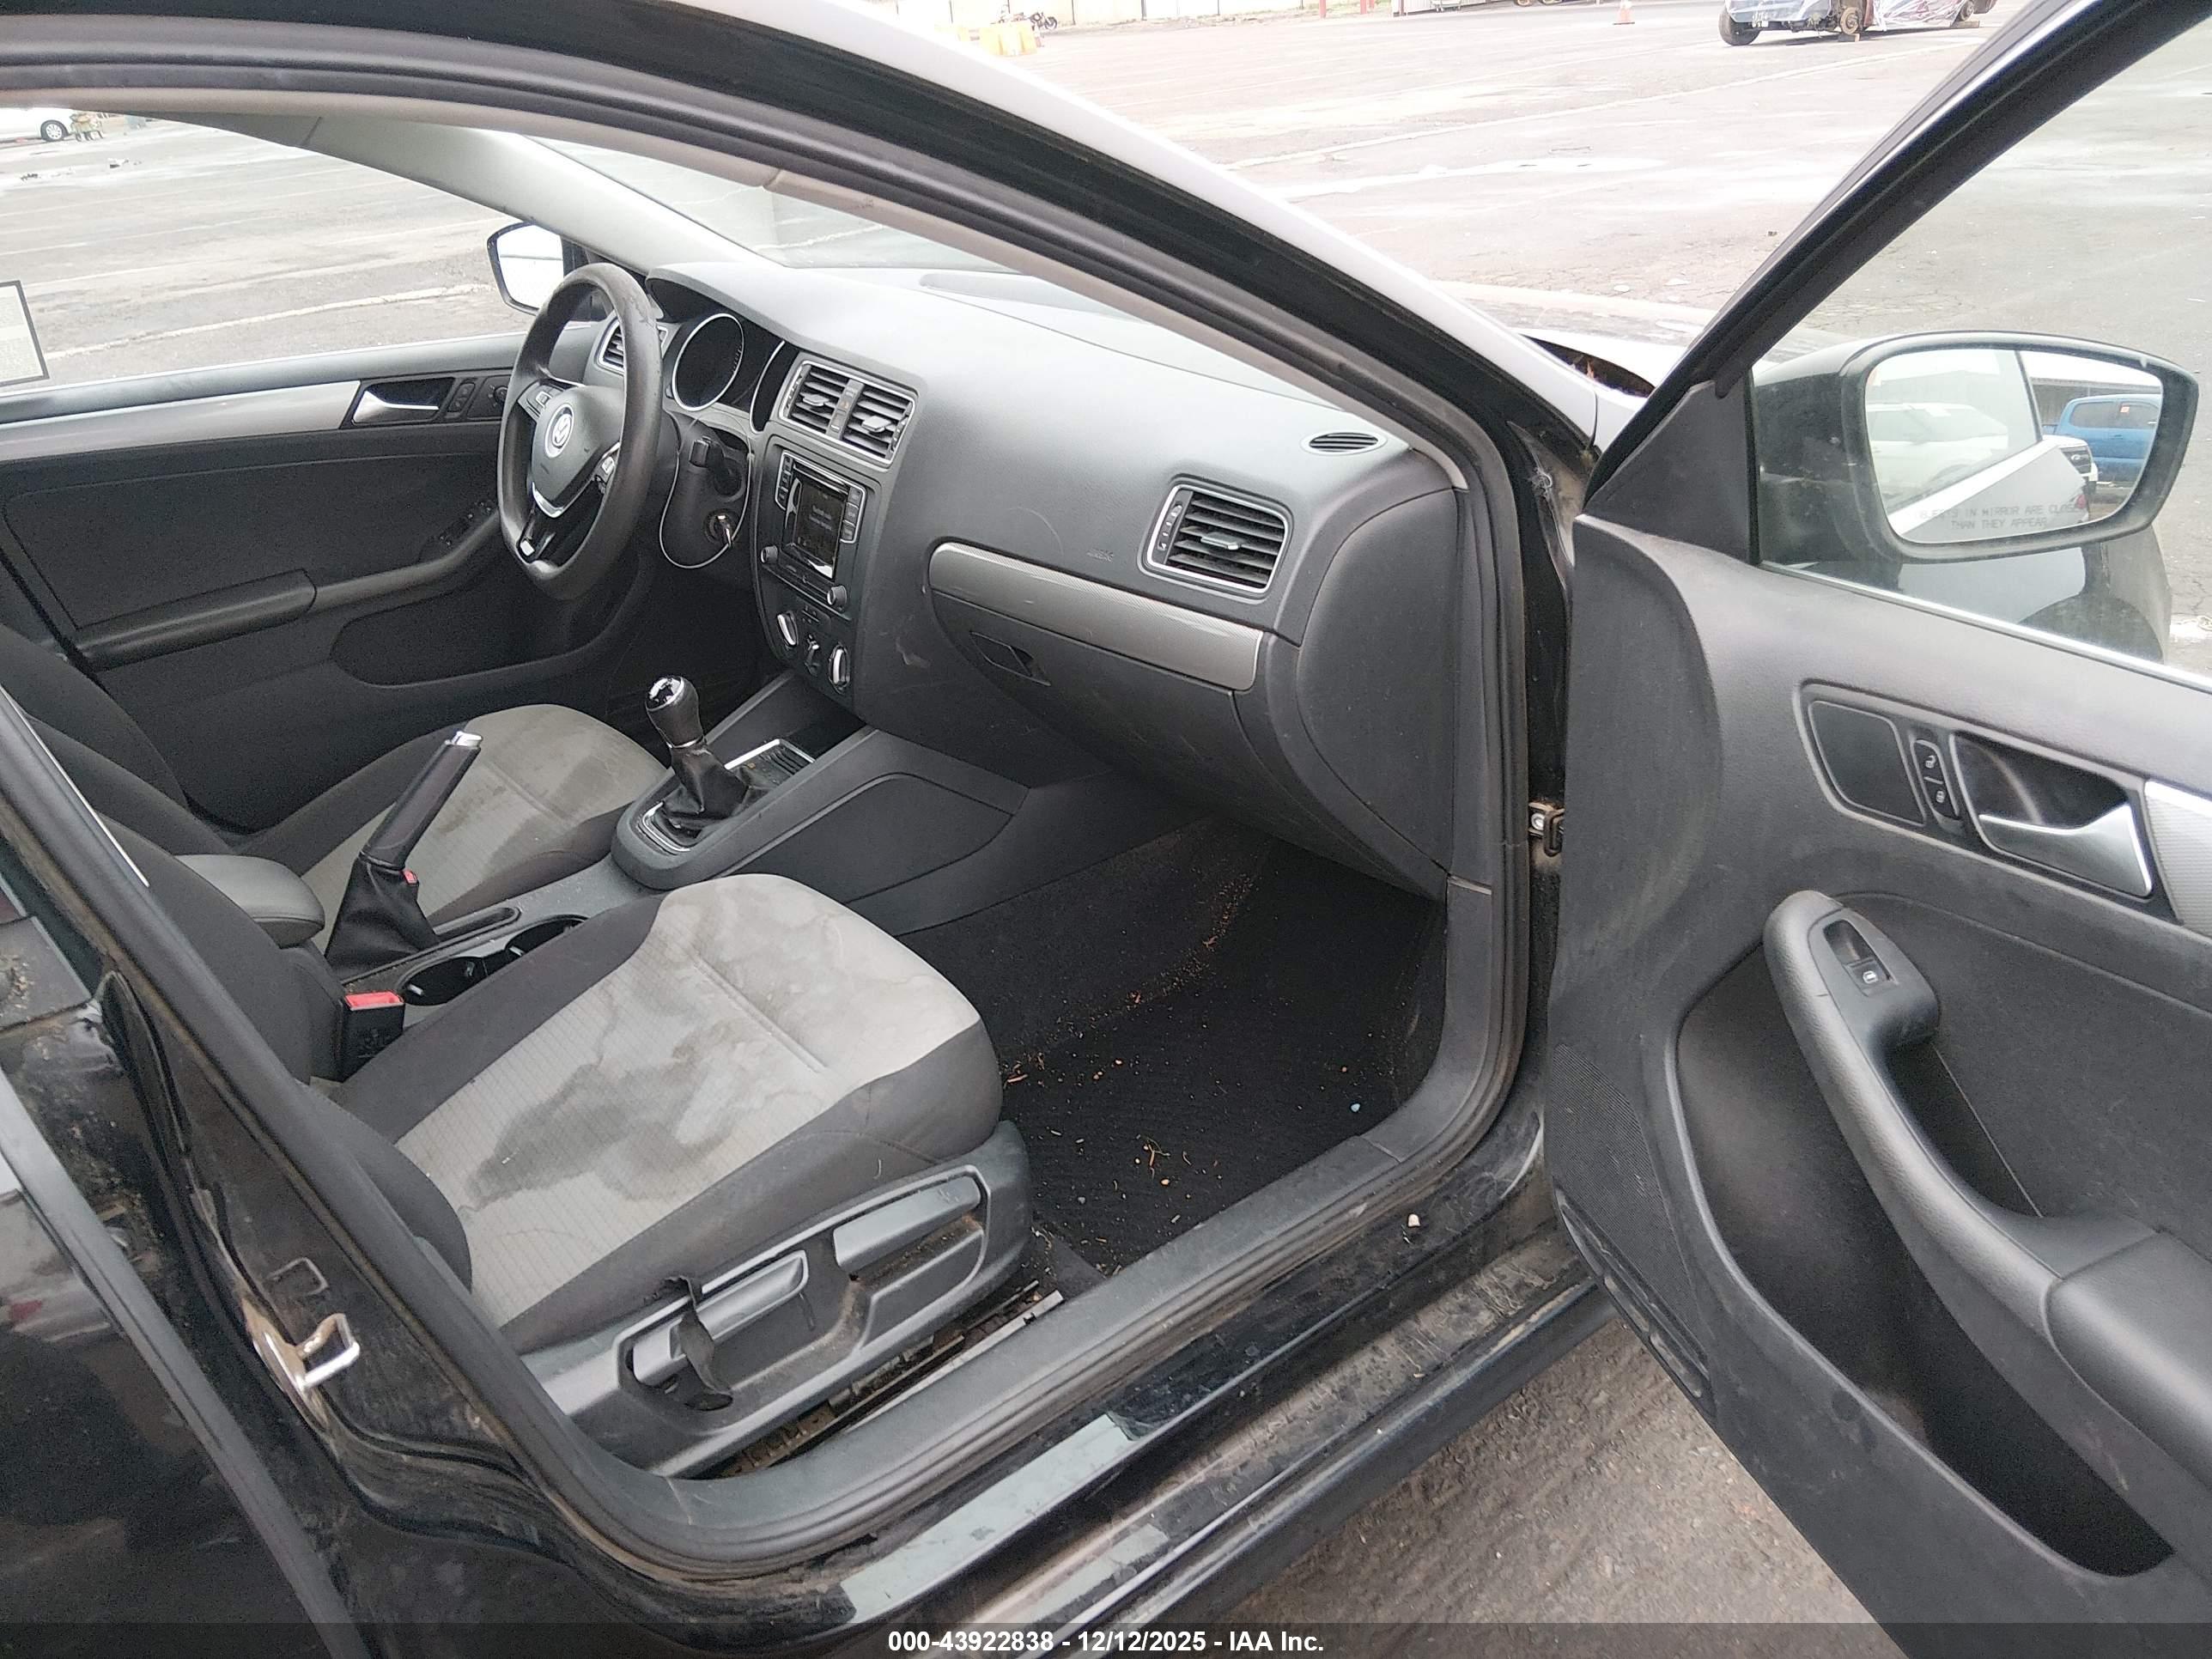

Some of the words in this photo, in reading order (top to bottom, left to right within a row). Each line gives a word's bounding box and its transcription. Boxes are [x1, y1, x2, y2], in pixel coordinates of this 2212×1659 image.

[1965, 507, 1977, 517] IN
[1982, 506, 2019, 517] MIRROR
[2025, 504, 2044, 515] ARE
[2049, 503, 2087, 514] CLOSE
[1950, 520, 1975, 530] THAN
[1982, 519, 2006, 530] THEY
[2012, 517, 2046, 528] APPEAR
